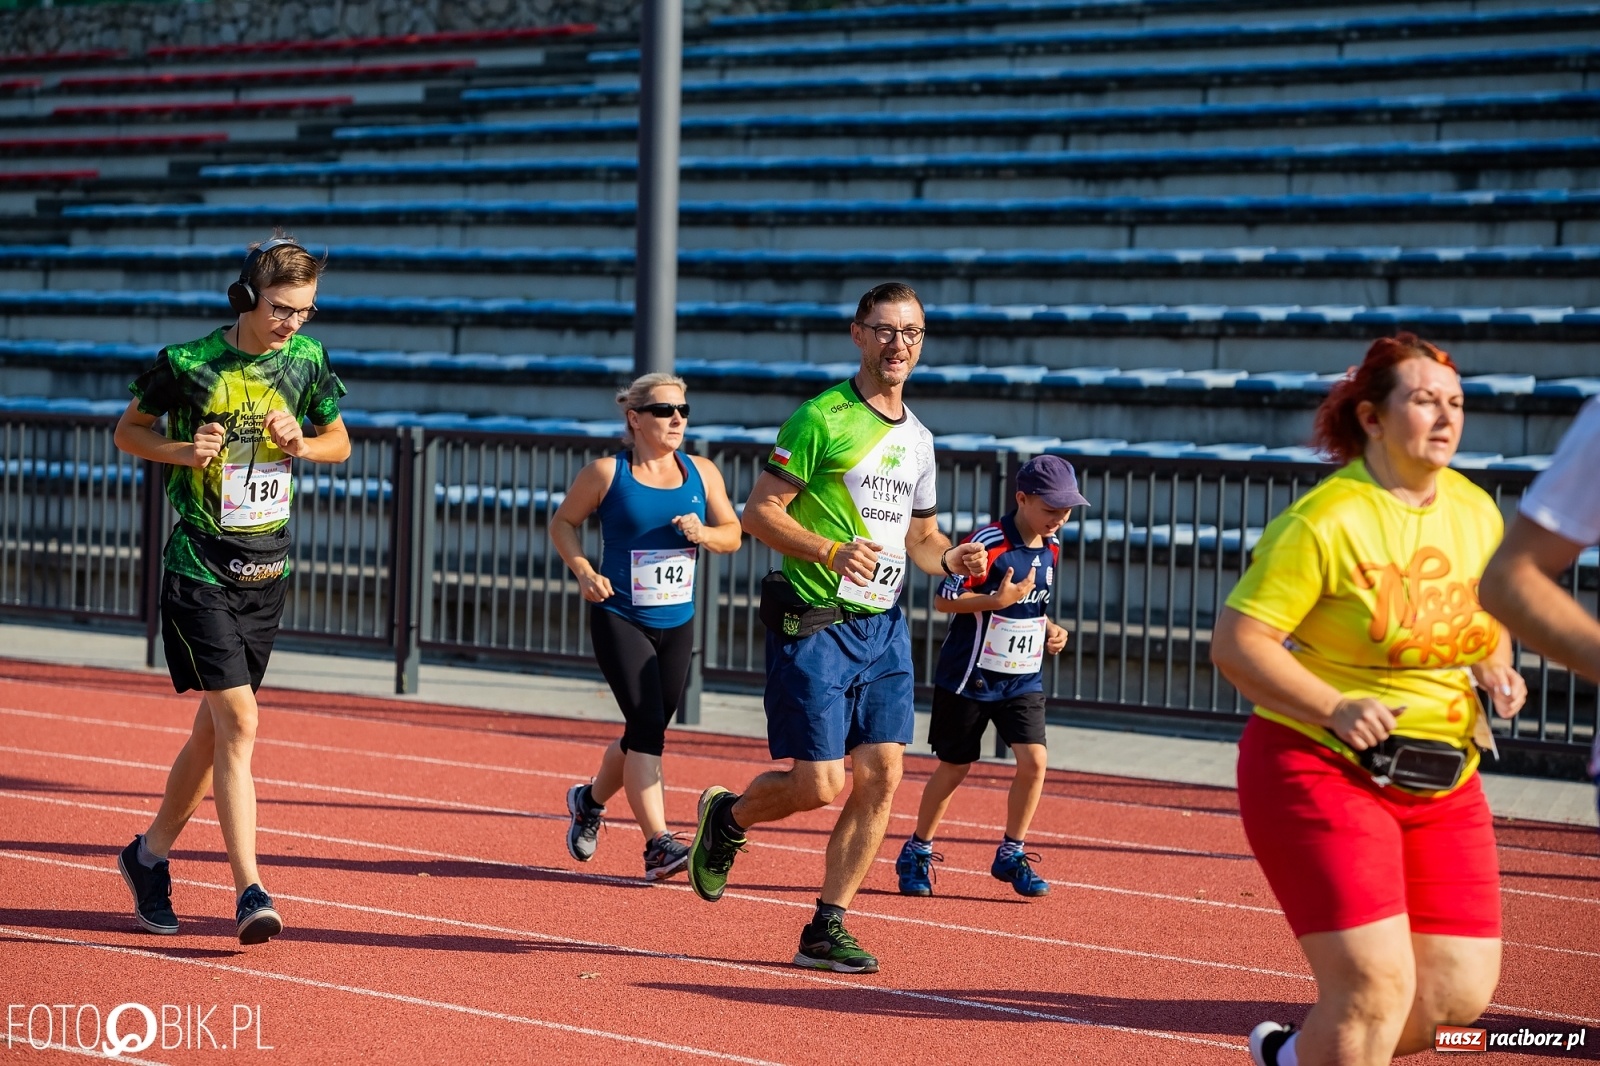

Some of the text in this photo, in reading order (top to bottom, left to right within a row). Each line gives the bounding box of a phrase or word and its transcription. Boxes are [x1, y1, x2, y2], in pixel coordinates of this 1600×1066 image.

[241, 401, 256, 413] IV
[240, 435, 271, 444] Rafame
[248, 479, 279, 503] 130
[654, 565, 684, 585] 142
[1007, 634, 1033, 655] 141
